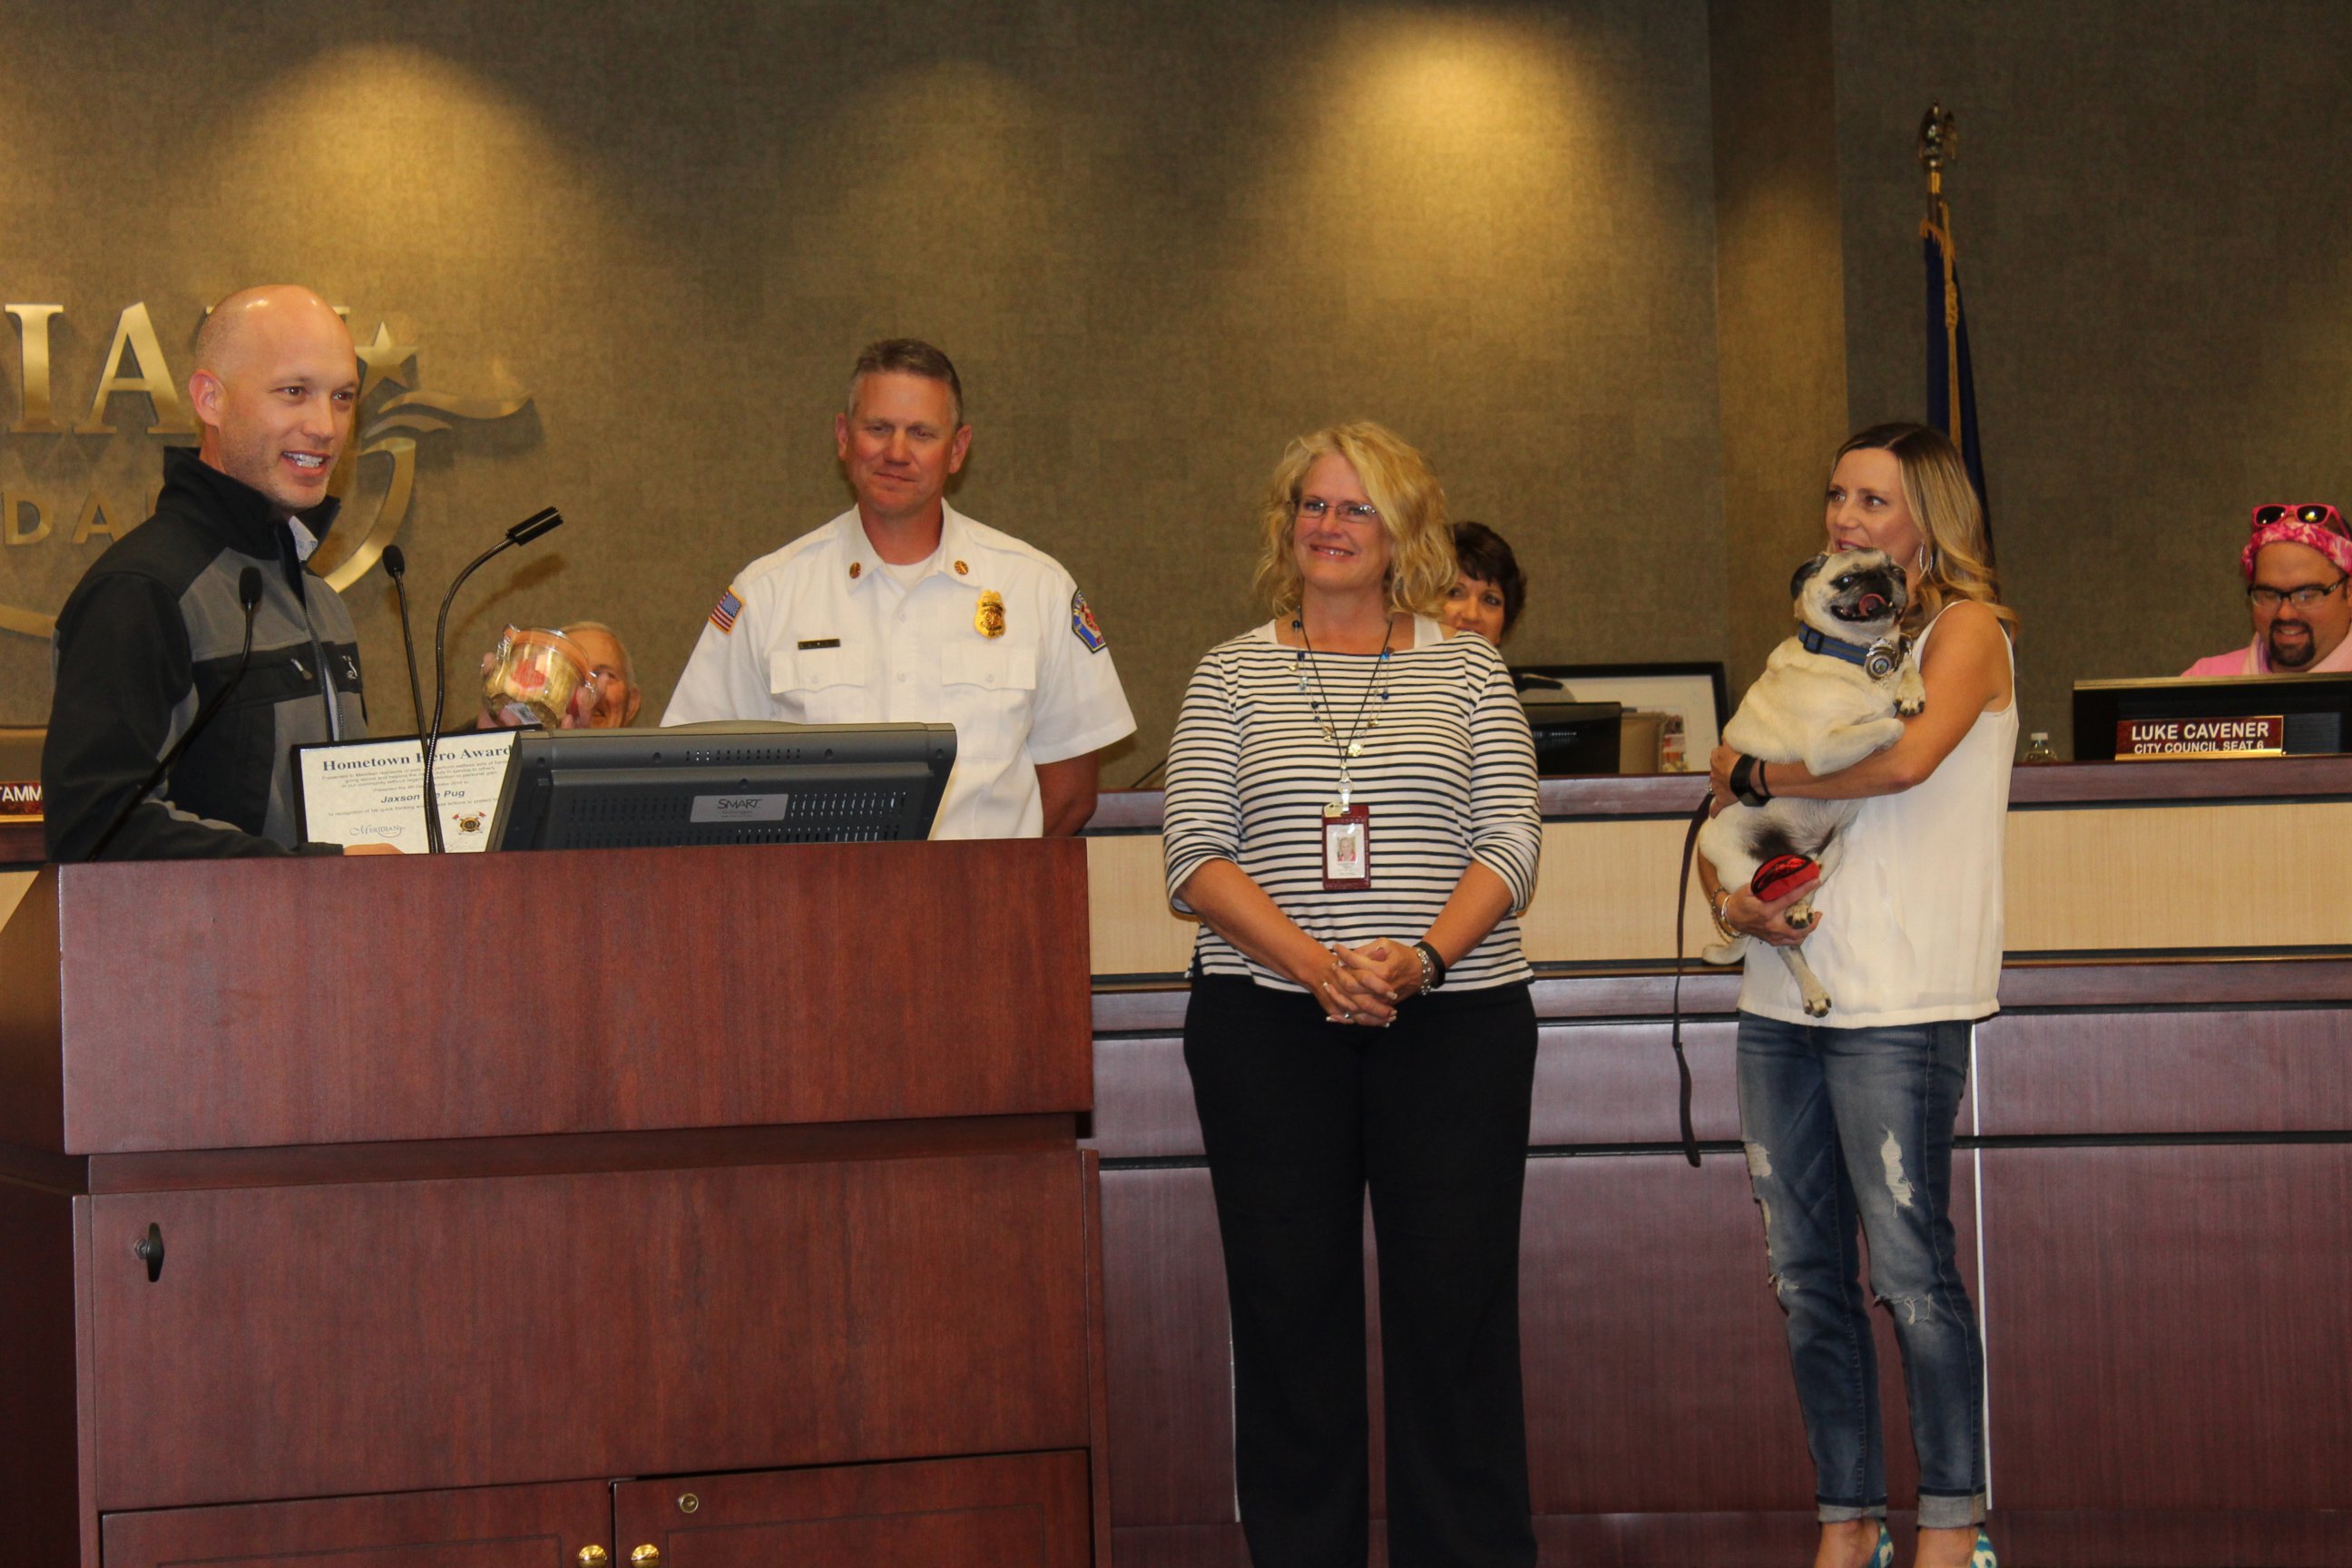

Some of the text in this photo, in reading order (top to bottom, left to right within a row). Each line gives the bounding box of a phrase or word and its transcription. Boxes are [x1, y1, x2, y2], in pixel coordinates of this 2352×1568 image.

[5, 301, 218, 434] IA
[2132, 721, 2269, 741] LUKE CAVENER
[2134, 740, 2264, 754] CITY COUNCIL SEAT 6
[323, 756, 410, 771] Hometown
[381, 793, 420, 804] Jaxson
[444, 789, 466, 799] Pug
[718, 799, 762, 809] SMART
